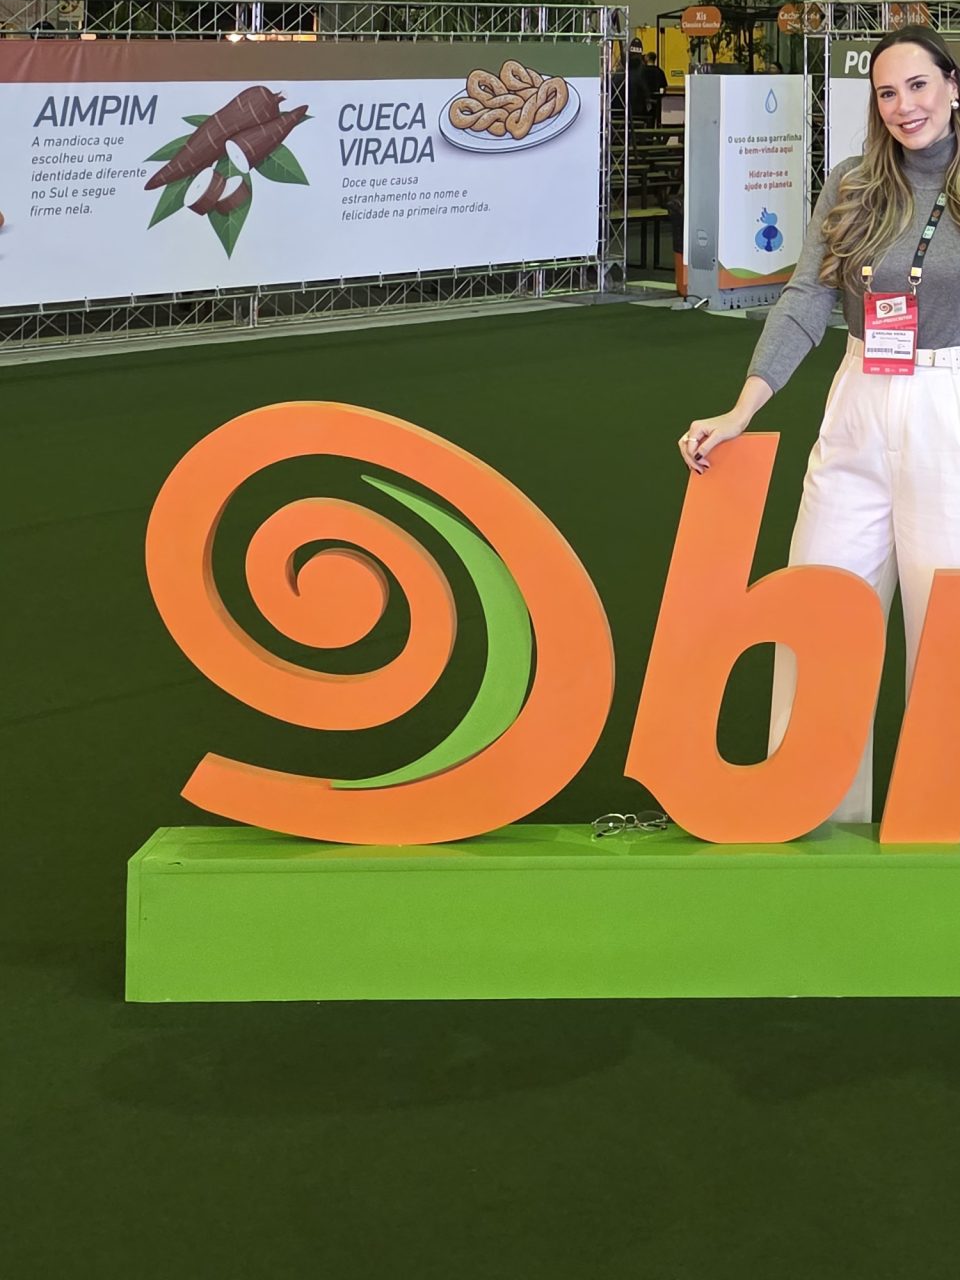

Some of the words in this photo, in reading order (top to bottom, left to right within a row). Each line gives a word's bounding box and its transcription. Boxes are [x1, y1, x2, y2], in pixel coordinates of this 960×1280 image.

[844, 51, 870, 75] PO
[33, 94, 158, 127] AIMPIM
[338, 102, 426, 132] CUECA
[31, 136, 40, 148] A
[43, 135, 100, 147] mandioca
[103, 136, 125, 148] que
[727, 136, 733, 144] O
[734, 136, 746, 144] uso
[747, 135, 755, 143] da
[756, 135, 768, 143] sua
[769, 133, 802, 144] garrafinha
[339, 136, 435, 167] VIRADA
[738, 146, 743, 155] é
[744, 146, 779, 155] bem-vinda
[780, 145, 794, 154] aqui
[31, 153, 84, 165] escolheu
[87, 153, 113, 163] uma
[31, 168, 93, 182] identidade
[95, 167, 148, 179] diferente
[748, 170, 783, 179] Hidrate-se
[342, 177, 367, 189] Doce
[369, 177, 388, 189] que
[390, 176, 419, 186] causa
[744, 182, 762, 192] ajude
[769, 181, 793, 190] planeta
[31, 190, 46, 200] no
[49, 186, 69, 199] Sul
[71, 188, 79, 198] e
[81, 187, 117, 199] segue
[341, 190, 417, 205] estranhamento
[419, 191, 432, 200] no
[433, 189, 460, 199] nome
[461, 189, 468, 198] e
[30, 205, 62, 217] firme
[65, 203, 93, 215] nela.
[341, 208, 390, 221] felicidade
[392, 209, 405, 218] na
[406, 205, 448, 219] primeira
[450, 202, 491, 214] mordida.
